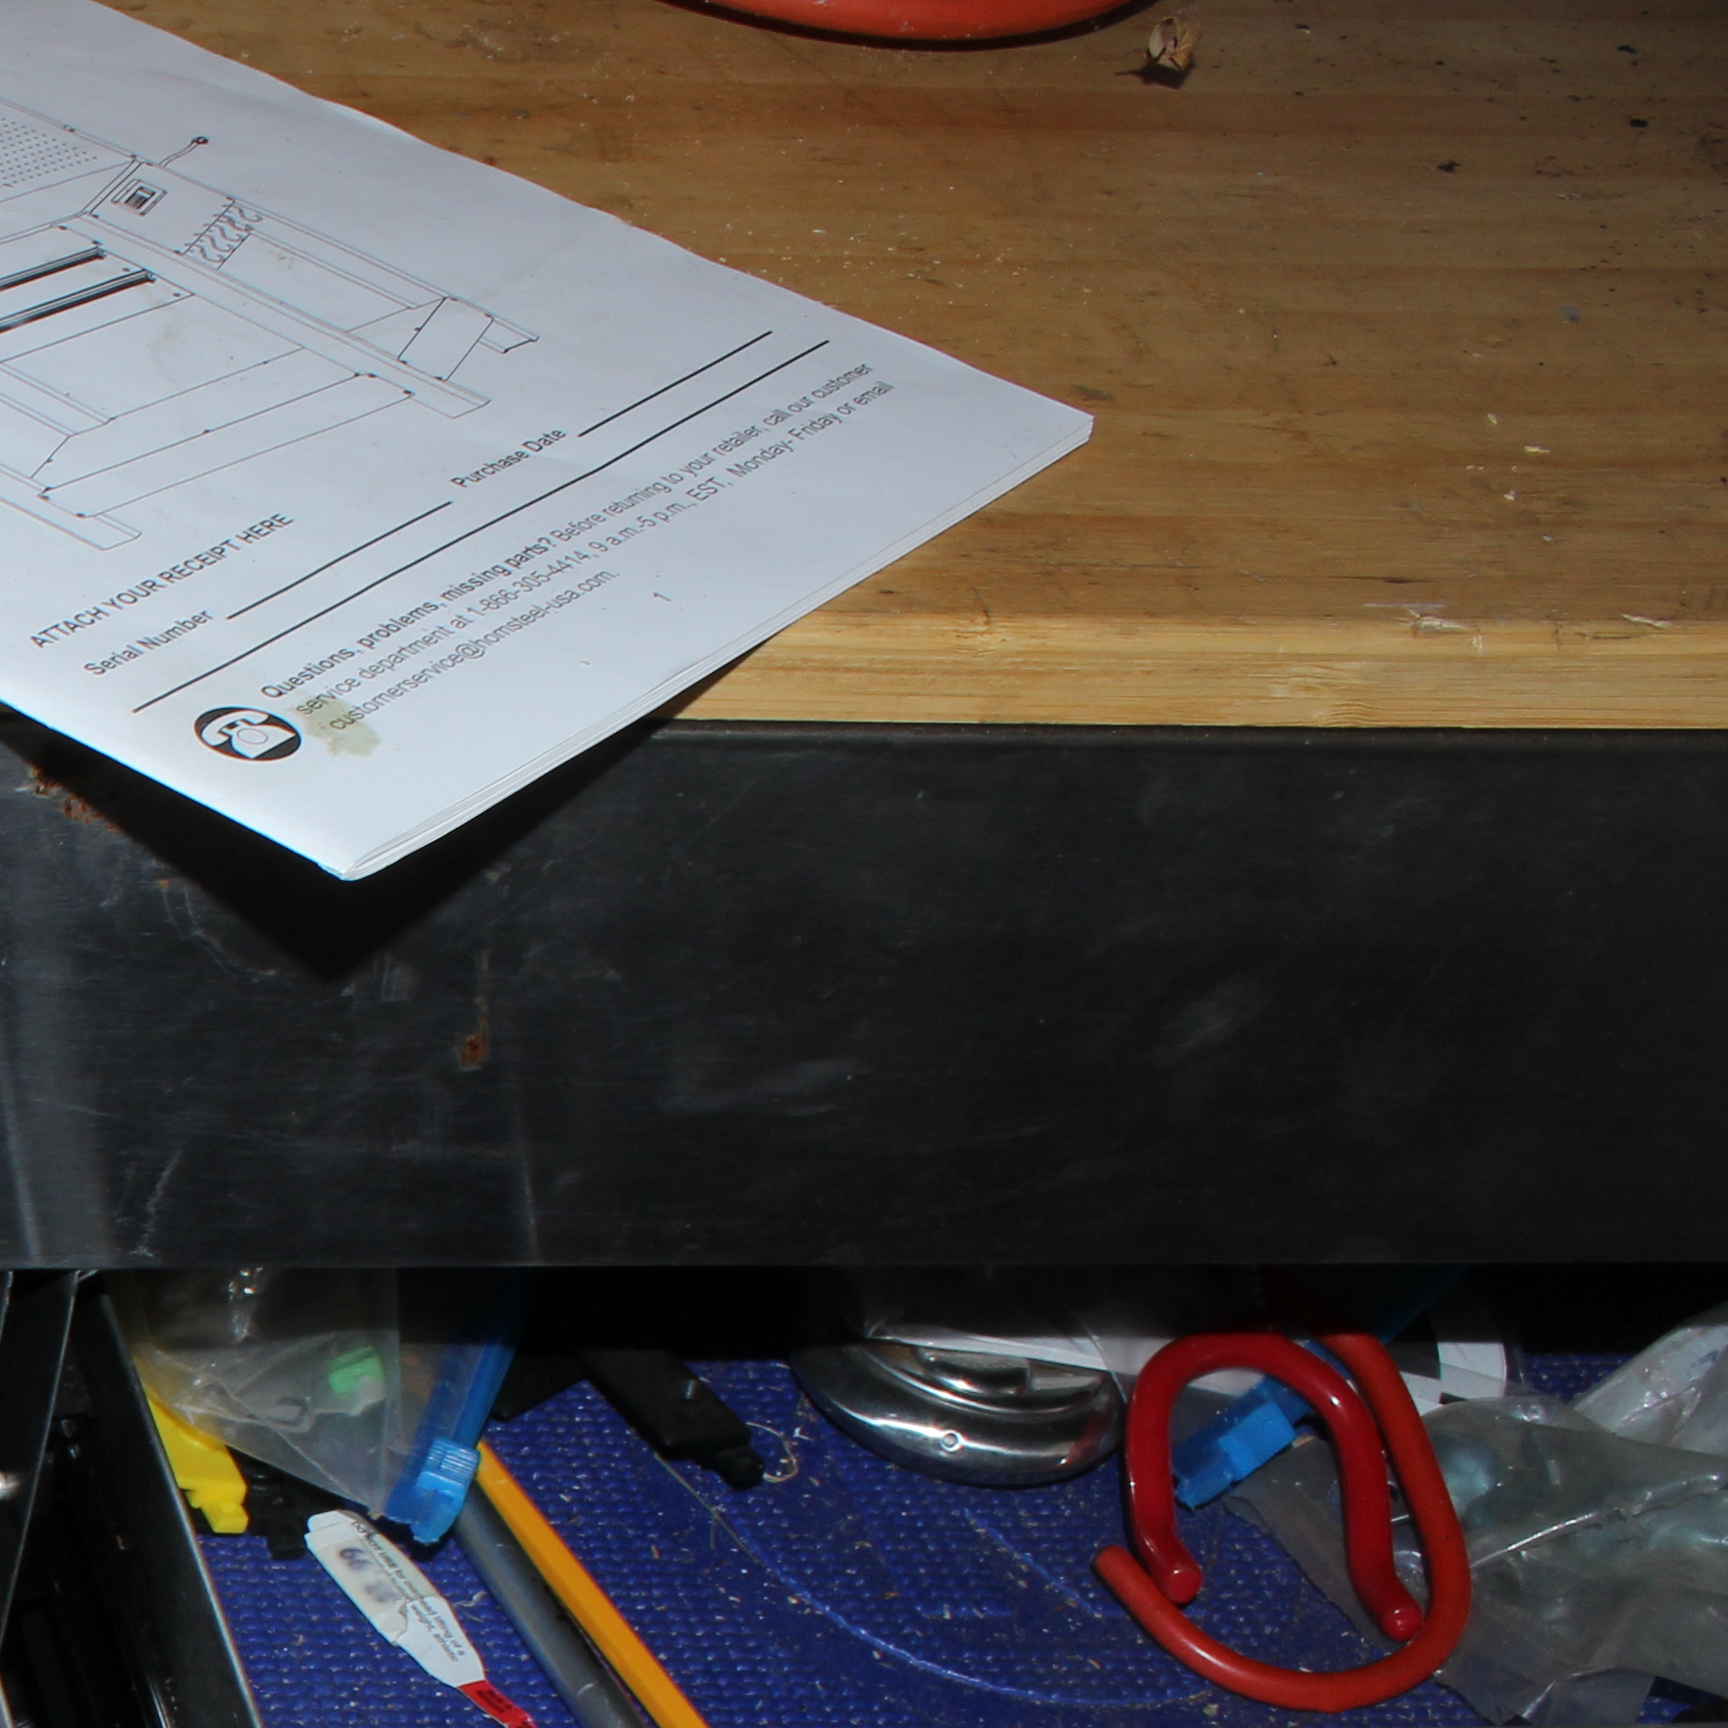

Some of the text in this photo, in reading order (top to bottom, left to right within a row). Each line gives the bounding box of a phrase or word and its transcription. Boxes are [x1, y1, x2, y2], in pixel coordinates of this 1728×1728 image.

[451, 426, 568, 489] Purchase Date
[29, 511, 295, 649] ATTACH YOUR RECEIPT HERE
[259, 361, 875, 699] Questions, problems, missing parts? Before returning to your retailer, call our customer
[295, 676, 362, 717] service
[358, 625, 454, 682] department
[449, 612, 474, 631] at
[587, 540, 610, 555] 9
[787, 409, 843, 443] Friday
[840, 401, 857, 416] or
[853, 379, 895, 407] email
[82, 607, 215, 678] Serial Number
